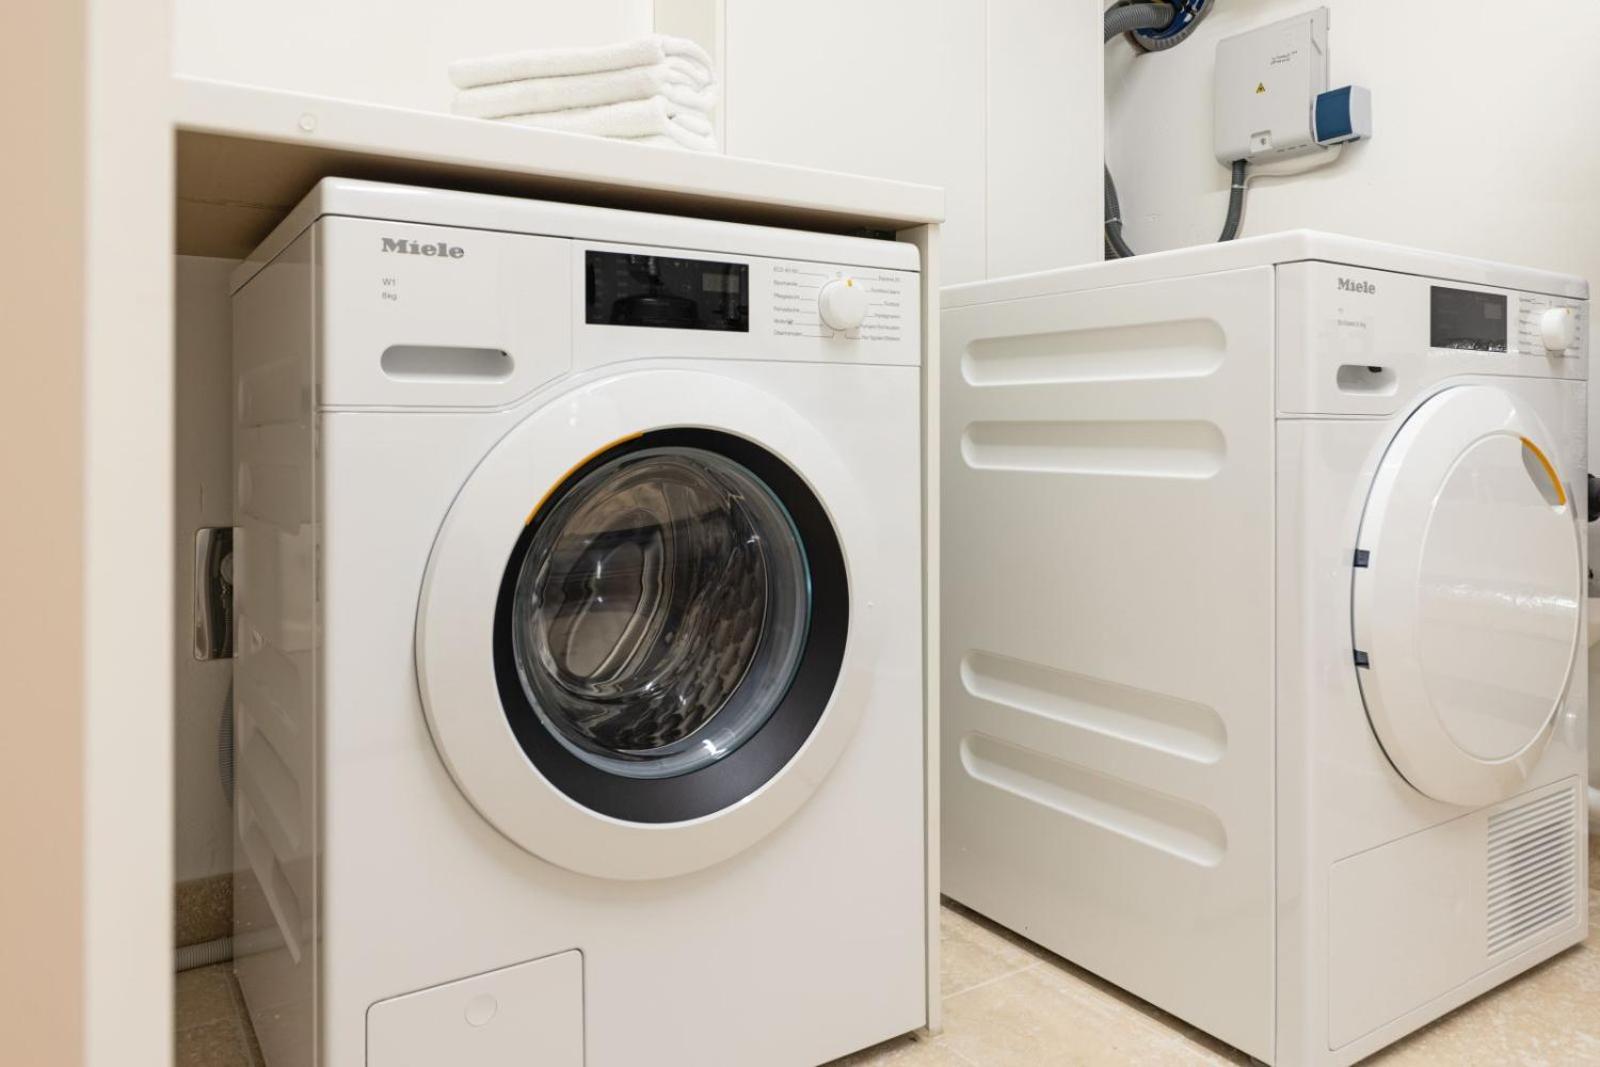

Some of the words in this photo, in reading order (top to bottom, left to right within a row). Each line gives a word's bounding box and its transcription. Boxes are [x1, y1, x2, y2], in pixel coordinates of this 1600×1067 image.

[381, 237, 465, 259] Miele
[382, 278, 396, 287] W1
[1337, 277, 1376, 295] Miele
